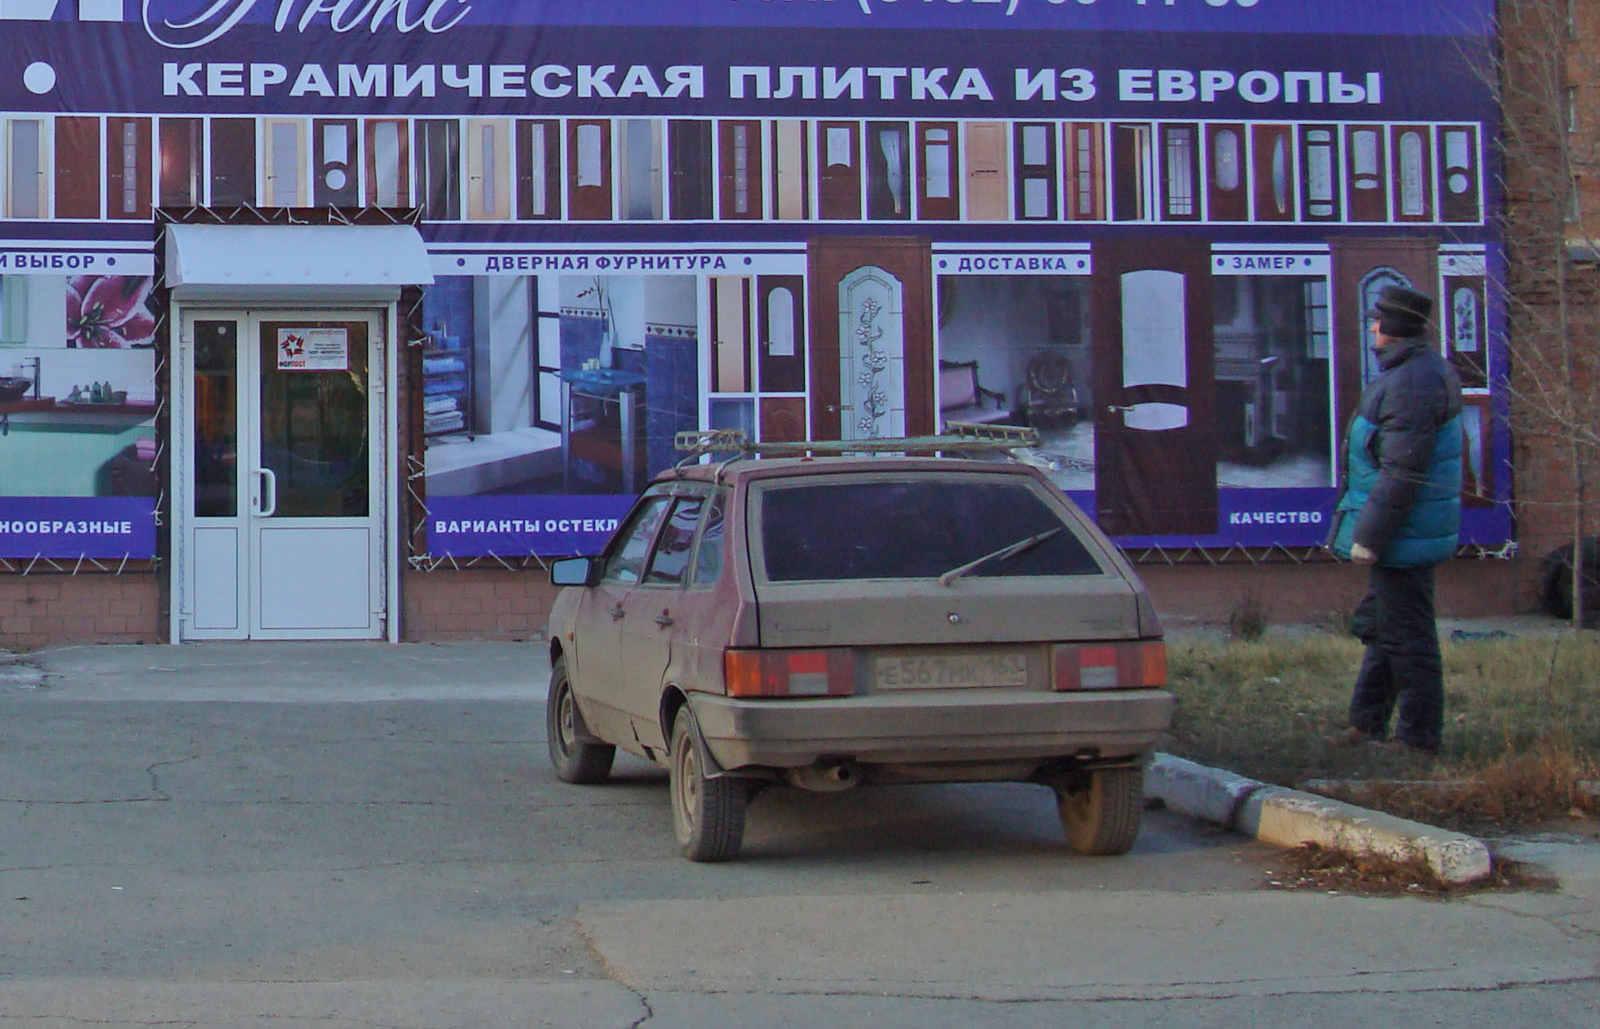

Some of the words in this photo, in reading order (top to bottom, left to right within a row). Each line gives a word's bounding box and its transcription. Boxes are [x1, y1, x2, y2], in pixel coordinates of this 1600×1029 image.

[164, 63, 703, 98] КЕРАМИЧЕСКАЯ
[730, 66, 993, 100] ПЛИТКА
[1015, 69, 1095, 101] ИЗ
[1119, 69, 1380, 103] ЕВРОПЫ
[15, 255, 94, 268] ВЫБОР
[484, 255, 590, 272] ДВЕРНАЯ
[595, 254, 727, 270] ФУРНИТУРА
[957, 256, 1068, 273] ДОСТАВКА
[1231, 255, 1297, 270] ЗАМЕР
[1230, 512, 1321, 524] КАЧЕСТВО
[436, 520, 539, 532] ВАРИАНТЫ
